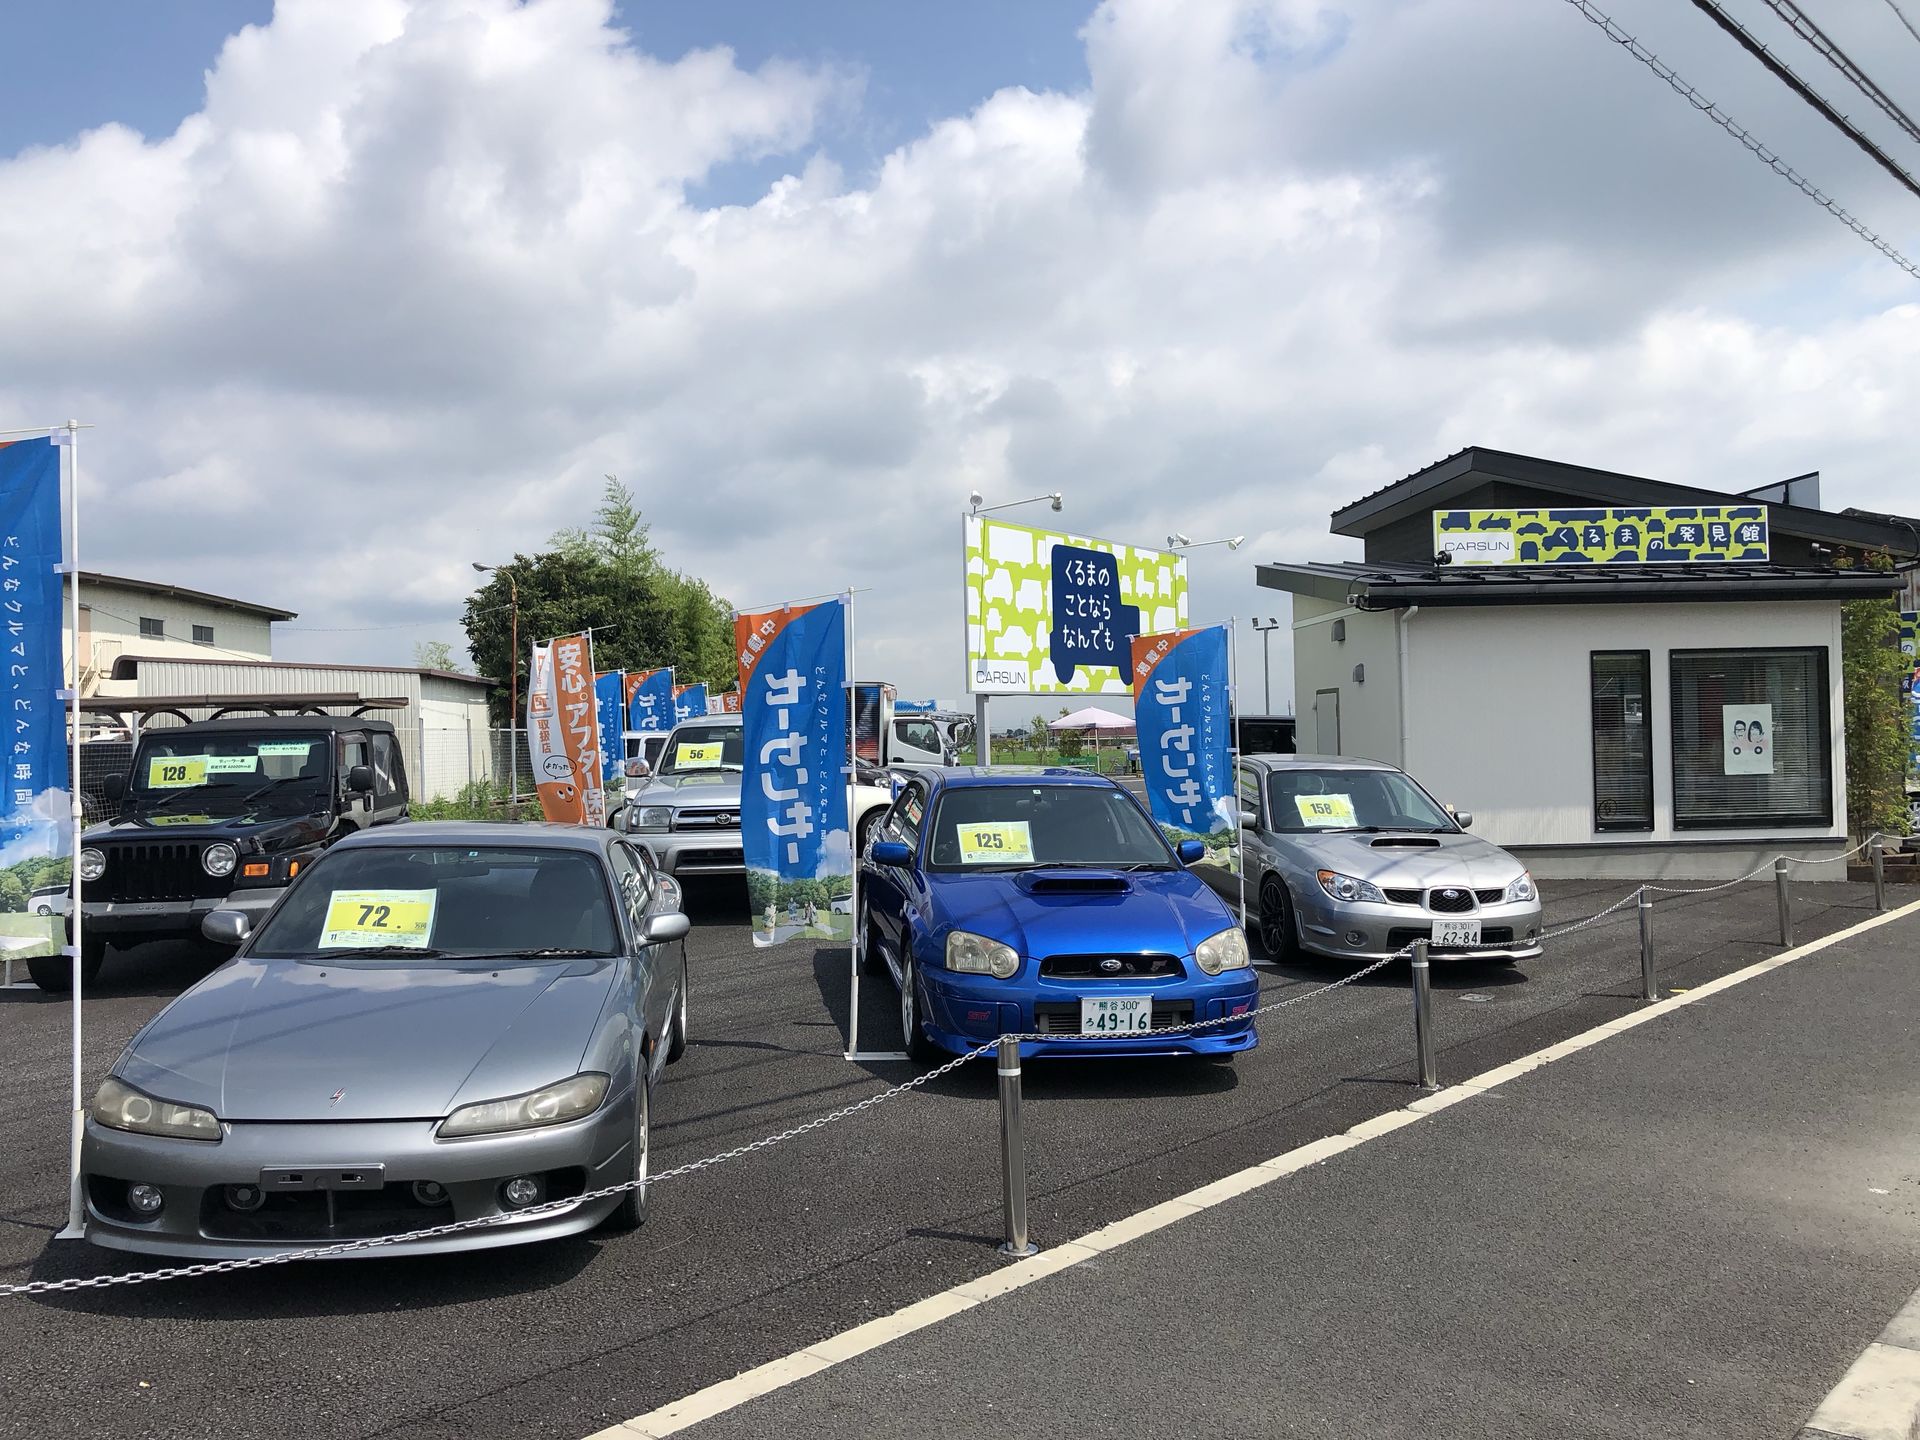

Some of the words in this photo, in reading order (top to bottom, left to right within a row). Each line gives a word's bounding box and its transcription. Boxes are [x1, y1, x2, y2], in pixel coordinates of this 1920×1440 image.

[1444, 541, 1510, 552] CARSUN
[1558, 523, 1762, 550] くるまの発見館
[1065, 560, 1110, 587] くるまの
[1065, 593, 1111, 620] ことなら
[740, 619, 776, 669] 掲載中
[1062, 621, 1114, 651] なんでも
[3, 535, 33, 840] どんなクルマと、どんな時間を。
[976, 670, 1026, 684] CARSUN
[639, 693, 660, 731] カーセ
[537, 720, 551, 754] 取扱店
[1155, 676, 1202, 824] カーセンサー
[759, 668, 814, 864] カーセンサー
[1442, 931, 1478, 944] 62-84
[1096, 1012, 1148, 1031] 49-16
